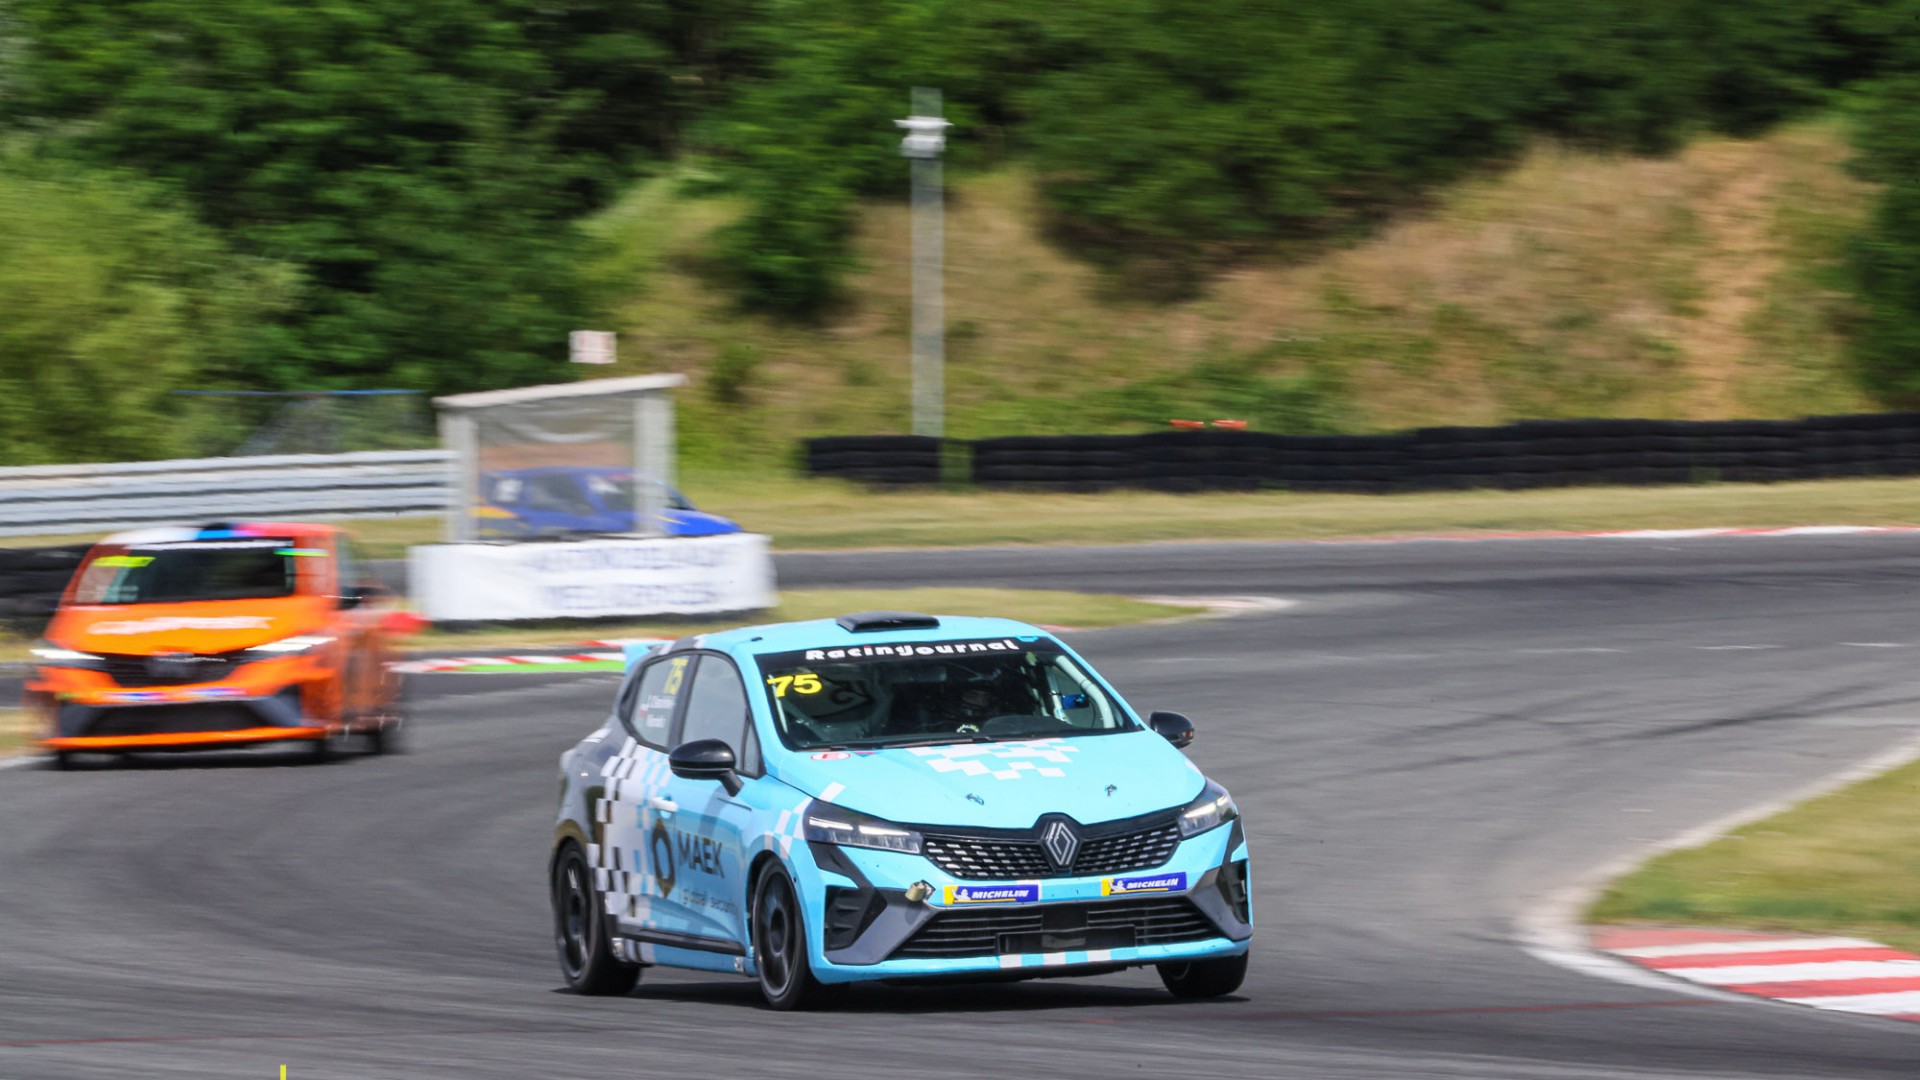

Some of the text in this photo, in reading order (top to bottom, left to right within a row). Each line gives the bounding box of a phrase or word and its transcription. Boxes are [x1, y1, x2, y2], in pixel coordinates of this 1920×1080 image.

[766, 673, 823, 698] 75
[677, 830, 724, 878] MAEK
[1126, 877, 1179, 889] MICHELIN
[970, 889, 1029, 899] MICHELIN
